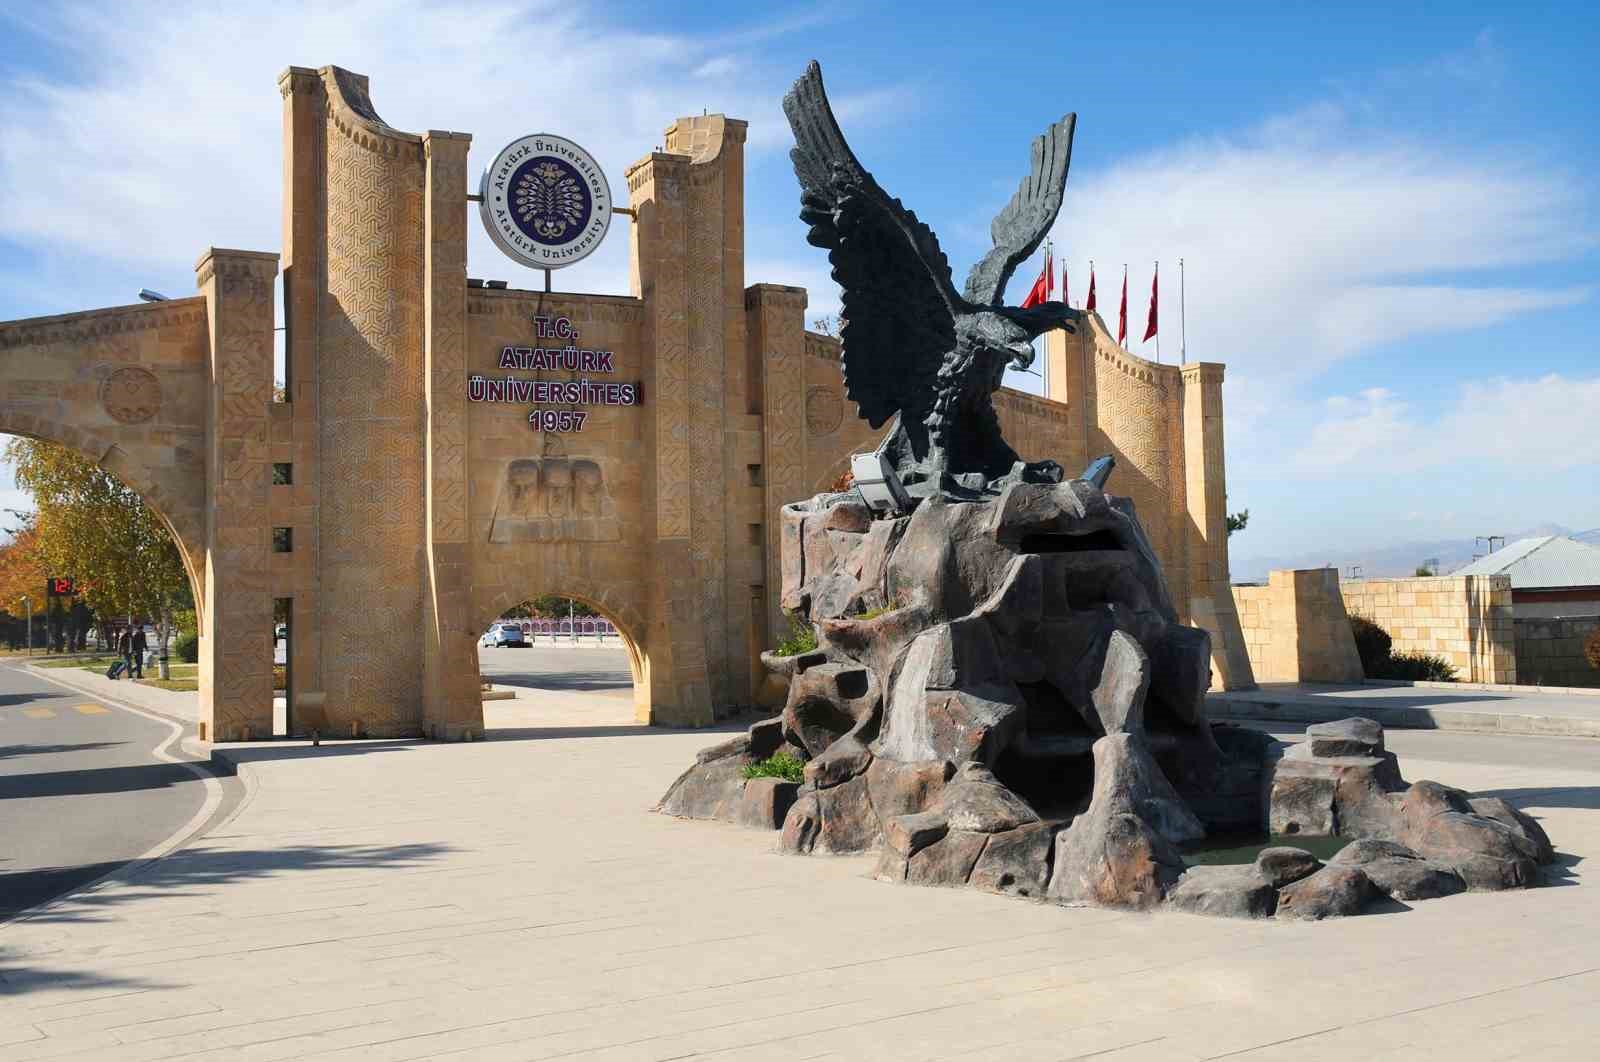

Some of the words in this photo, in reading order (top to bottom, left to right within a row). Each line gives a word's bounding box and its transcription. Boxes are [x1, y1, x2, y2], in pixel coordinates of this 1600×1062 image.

[495, 144, 531, 190] Atatürk
[535, 139, 604, 200] Üniversitesi
[496, 208, 537, 255] Atatürk
[542, 218, 605, 259] University
[534, 315, 580, 339] T.C.
[499, 345, 615, 373] ATATÜRK
[529, 410, 589, 433] 1957
